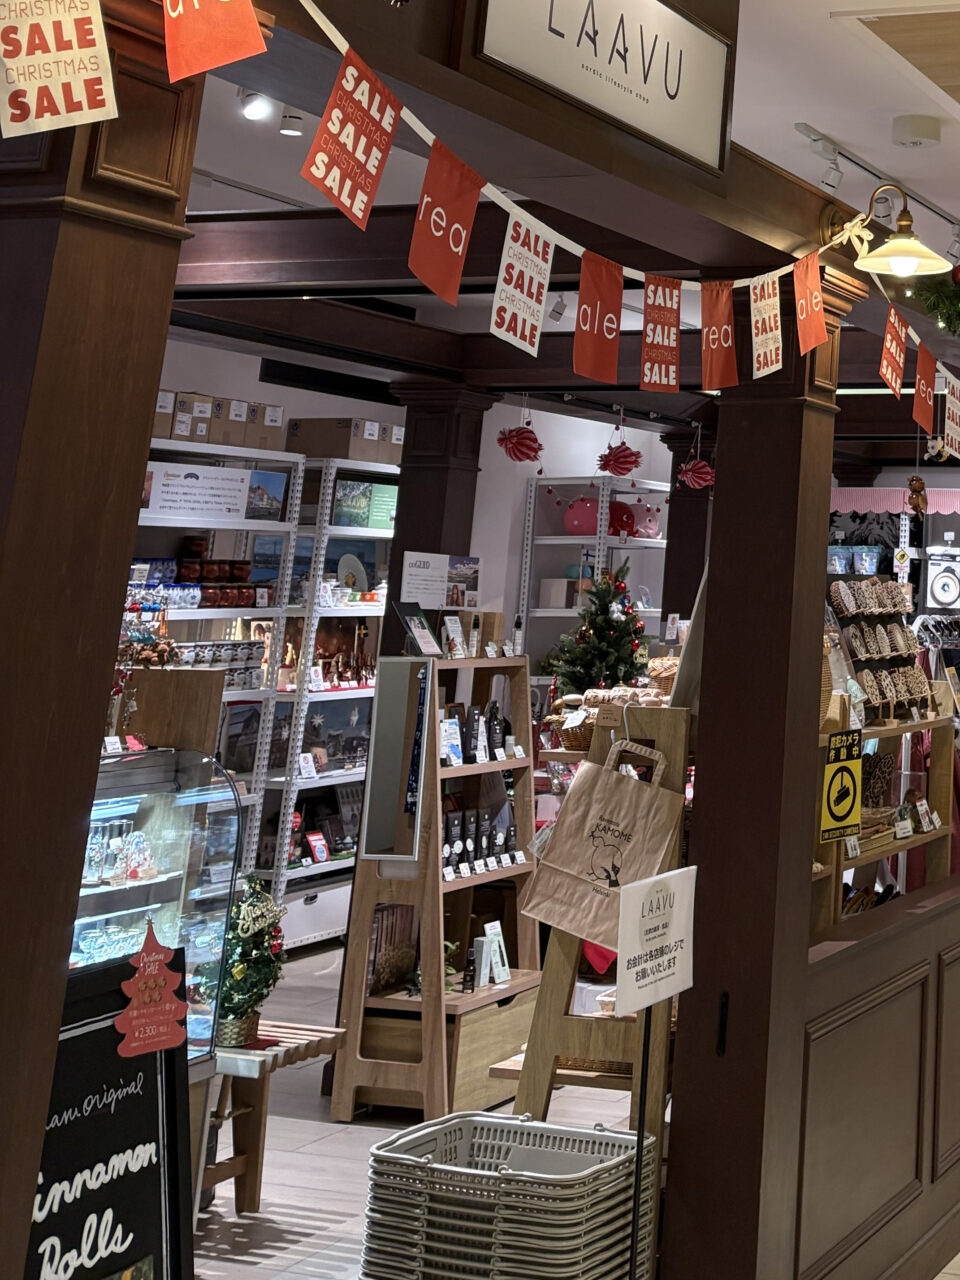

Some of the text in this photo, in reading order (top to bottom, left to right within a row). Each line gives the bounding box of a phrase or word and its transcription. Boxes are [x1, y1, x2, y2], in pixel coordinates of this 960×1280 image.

[0, 16, 97, 59] SALE
[5, 55, 100, 85] CHRISTMAS
[8, 76, 106, 123] SALE
[341, 65, 396, 133] SALE
[336, 90, 388, 149] CHRISTMAS
[326, 108, 382, 176] SALE
[320, 134, 373, 192] CHRISTMAS
[310, 151, 368, 220] SALE
[419, 194, 467, 256] rea
[510, 220, 551, 264] SALE
[507, 246, 548, 280] CHRISTMAS
[503, 262, 545, 305] SALE
[646, 284, 679, 309] SALE
[752, 280, 778, 304] SALE
[499, 288, 540, 322] CHRISTMAS
[580, 301, 617, 339] ale
[798, 289, 822, 320] ale
[494, 305, 538, 348] SALE
[645, 323, 677, 347] SALE
[702, 324, 732, 350] rea
[754, 313, 779, 338] SALE
[889, 307, 906, 343] SALE
[755, 346, 780, 372] SALE
[885, 333, 904, 368] SALE
[643, 362, 677, 385] SALE
[881, 359, 901, 394] SALE
[945, 432, 960, 455] SALE
[829, 733, 859, 749] 防犯カメラ
[595, 823, 632, 843] KAMOME
[641, 891, 675, 918] LAAVU
[635, 956, 677, 983] お願いいたします
[32, 1141, 158, 1223] innamon
